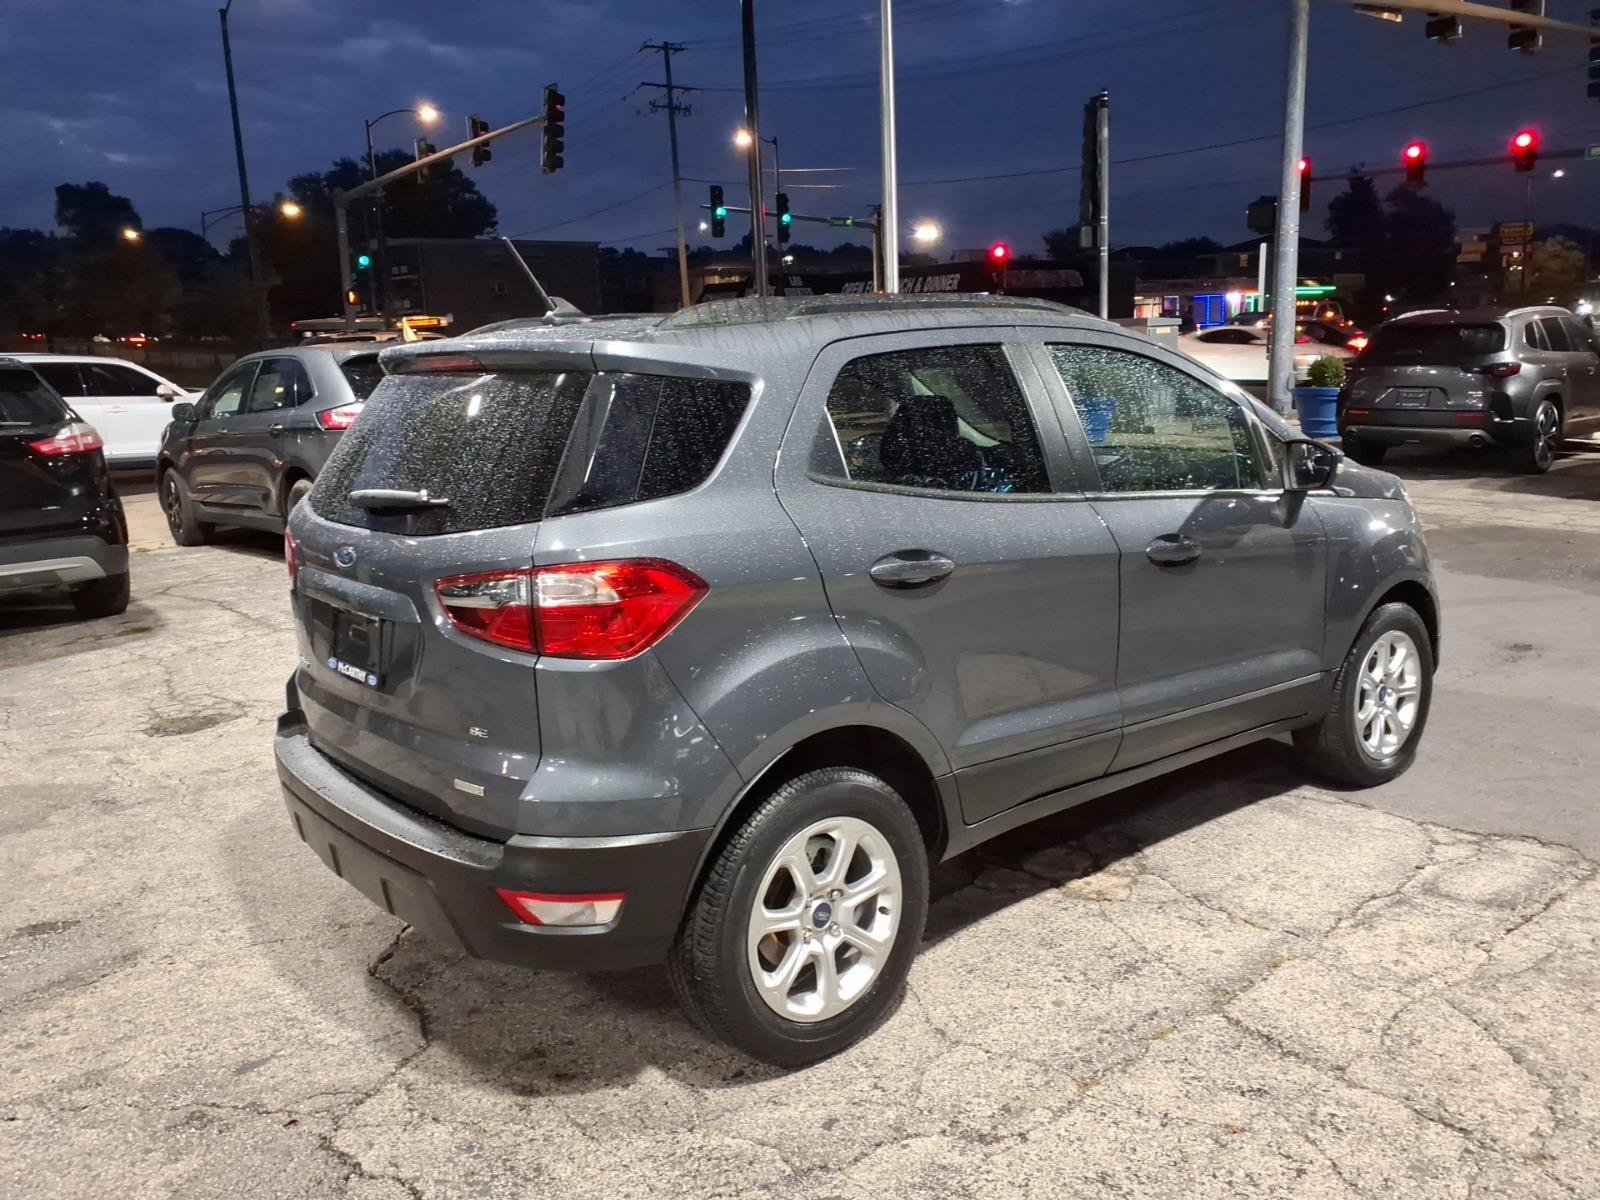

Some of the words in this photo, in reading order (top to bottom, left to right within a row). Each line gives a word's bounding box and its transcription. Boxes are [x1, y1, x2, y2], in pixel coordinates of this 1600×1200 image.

[914, 277, 923, 292] &
[923, 273, 961, 292] DINNER
[469, 726, 489, 739] SE
